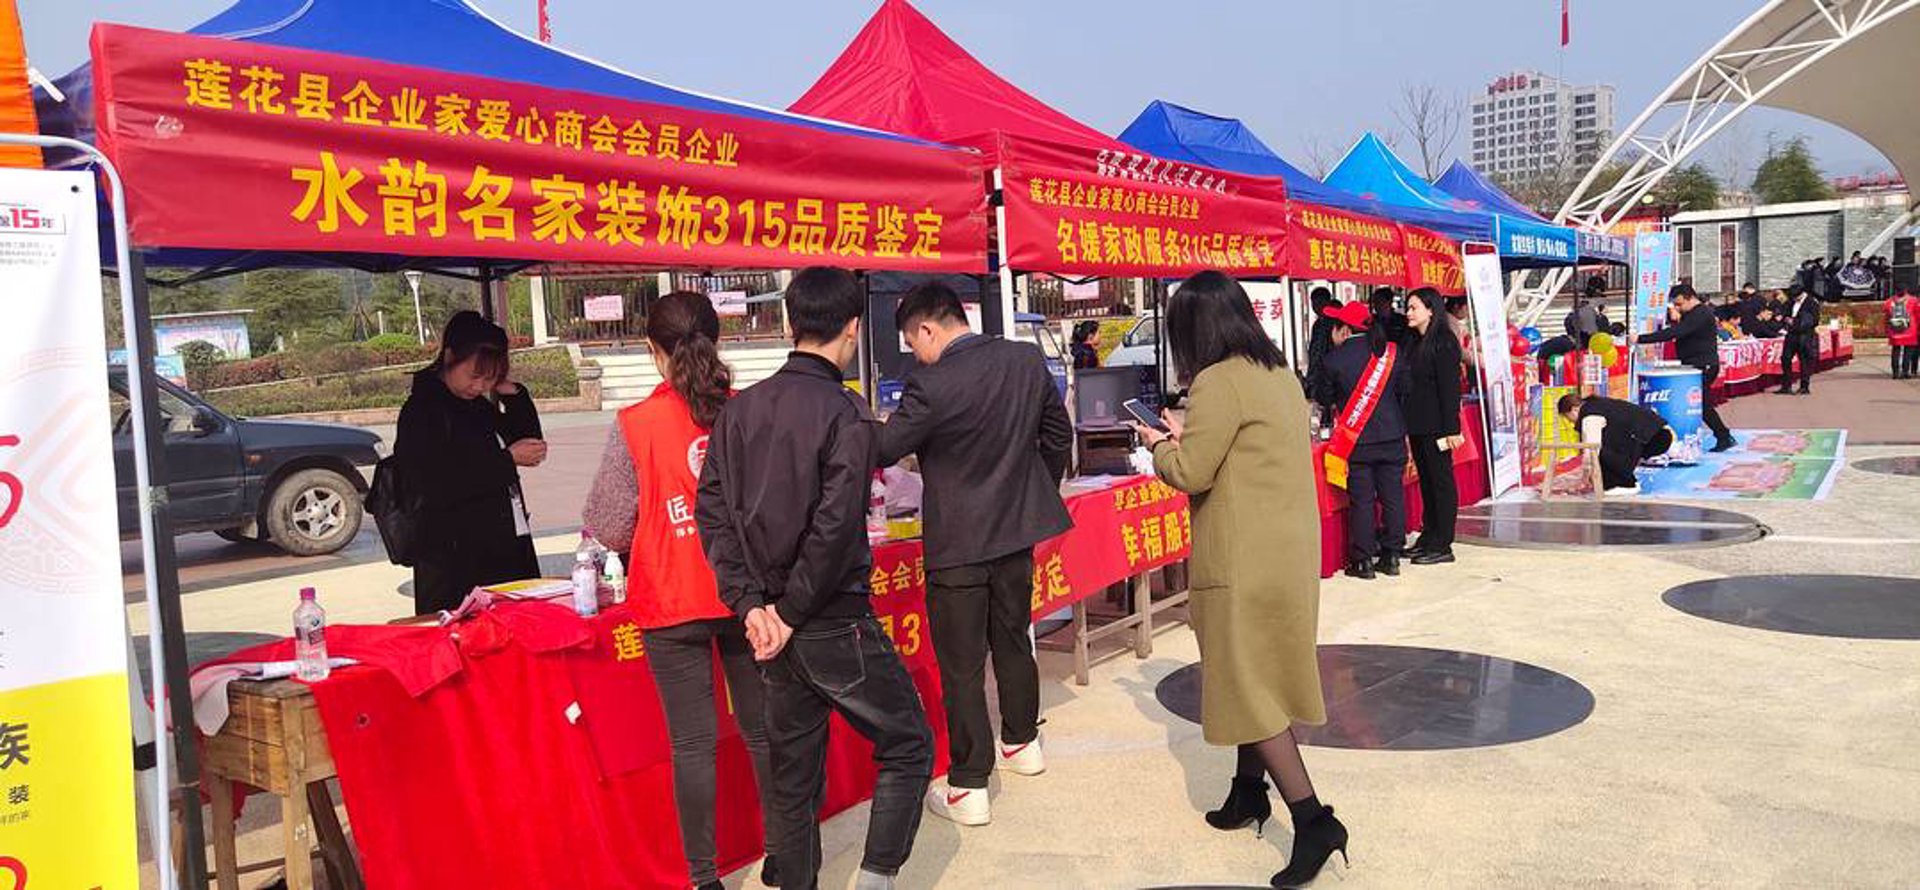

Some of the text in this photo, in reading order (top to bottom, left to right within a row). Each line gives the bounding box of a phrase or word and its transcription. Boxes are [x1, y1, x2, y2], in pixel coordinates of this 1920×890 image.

[184, 58, 739, 168] 莲花县企业家爱心商会会员企业
[291, 152, 943, 260] 水韵名家装饰315品质鉴定
[1028, 178, 1201, 220] 莲花县企业家爱心商会会员企业
[1057, 219, 1276, 269] 名媛家政服务315品质鉴定
[666, 495, 694, 525] 匠
[612, 621, 645, 662] 莲
[8, 785, 29, 805] 装
